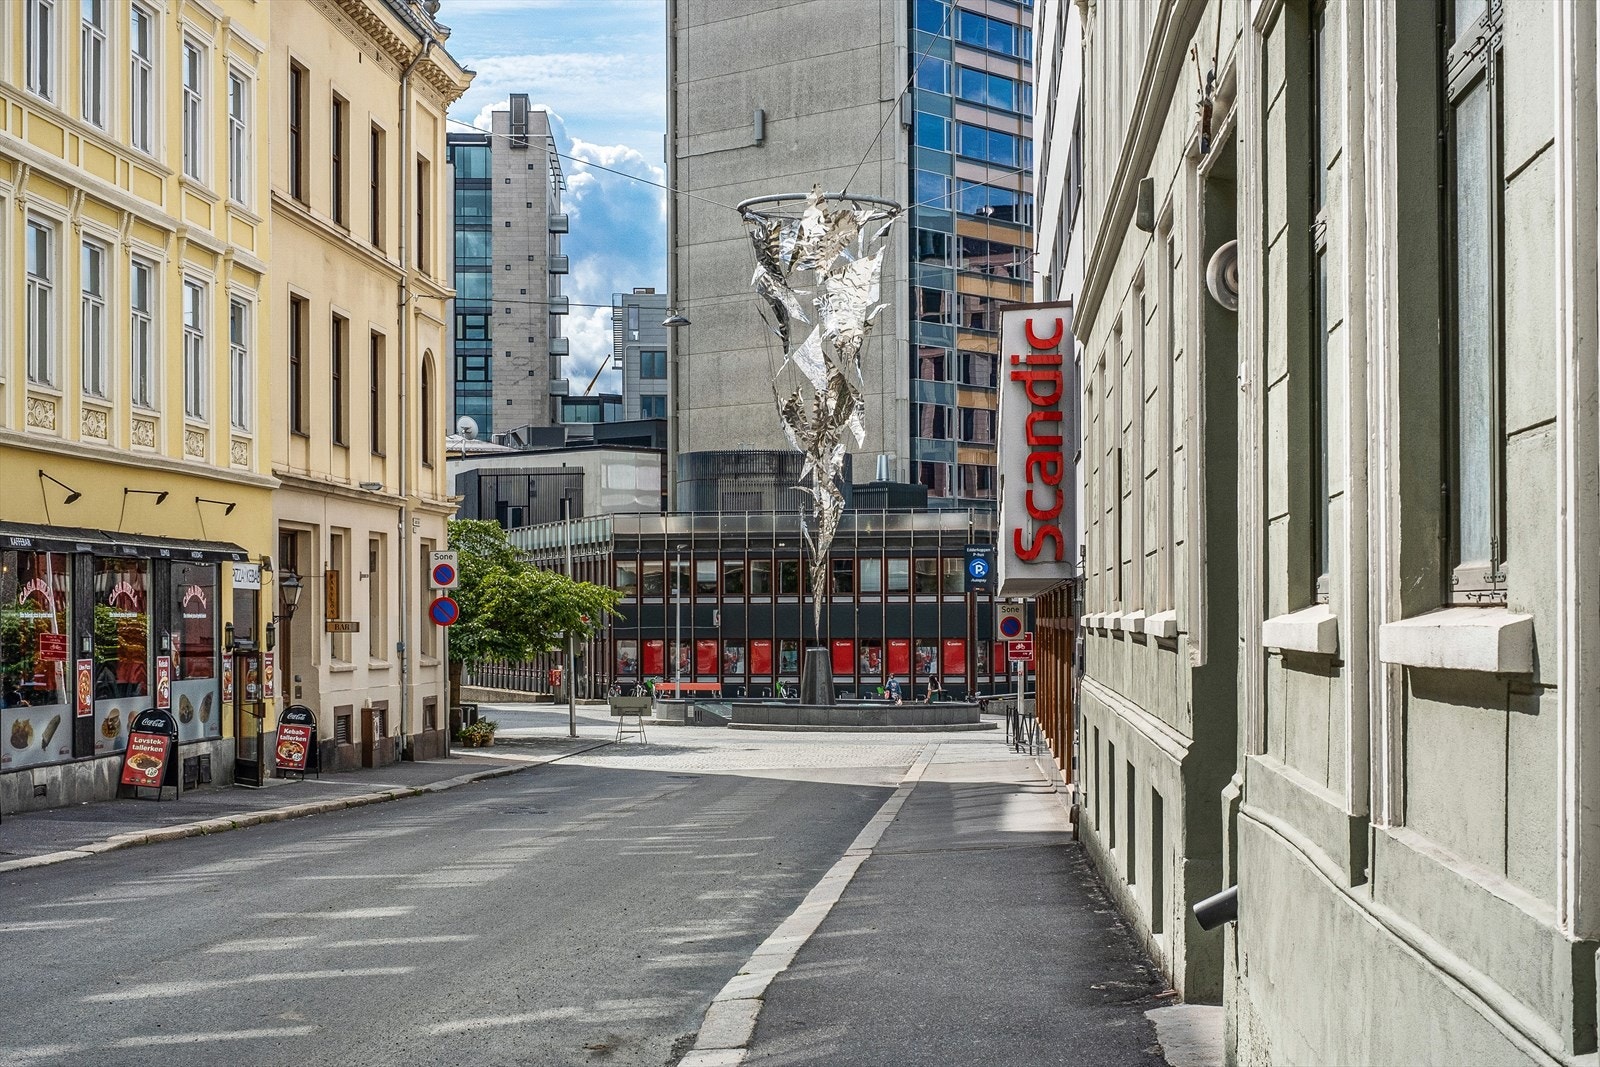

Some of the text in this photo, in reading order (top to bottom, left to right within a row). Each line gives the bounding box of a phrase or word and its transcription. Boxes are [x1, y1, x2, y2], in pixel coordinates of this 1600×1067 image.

[1010, 318, 1063, 561] Scandic
[975, 565, 983, 575] P
[334, 623, 350, 631] BAR
[287, 713, 307, 721] Coca-Cola
[142, 718, 165, 728] Coca-Cola
[134, 736, 164, 745] Løvstek-
[280, 734, 307, 742] tallerken
[132, 744, 163, 753] tallerken
